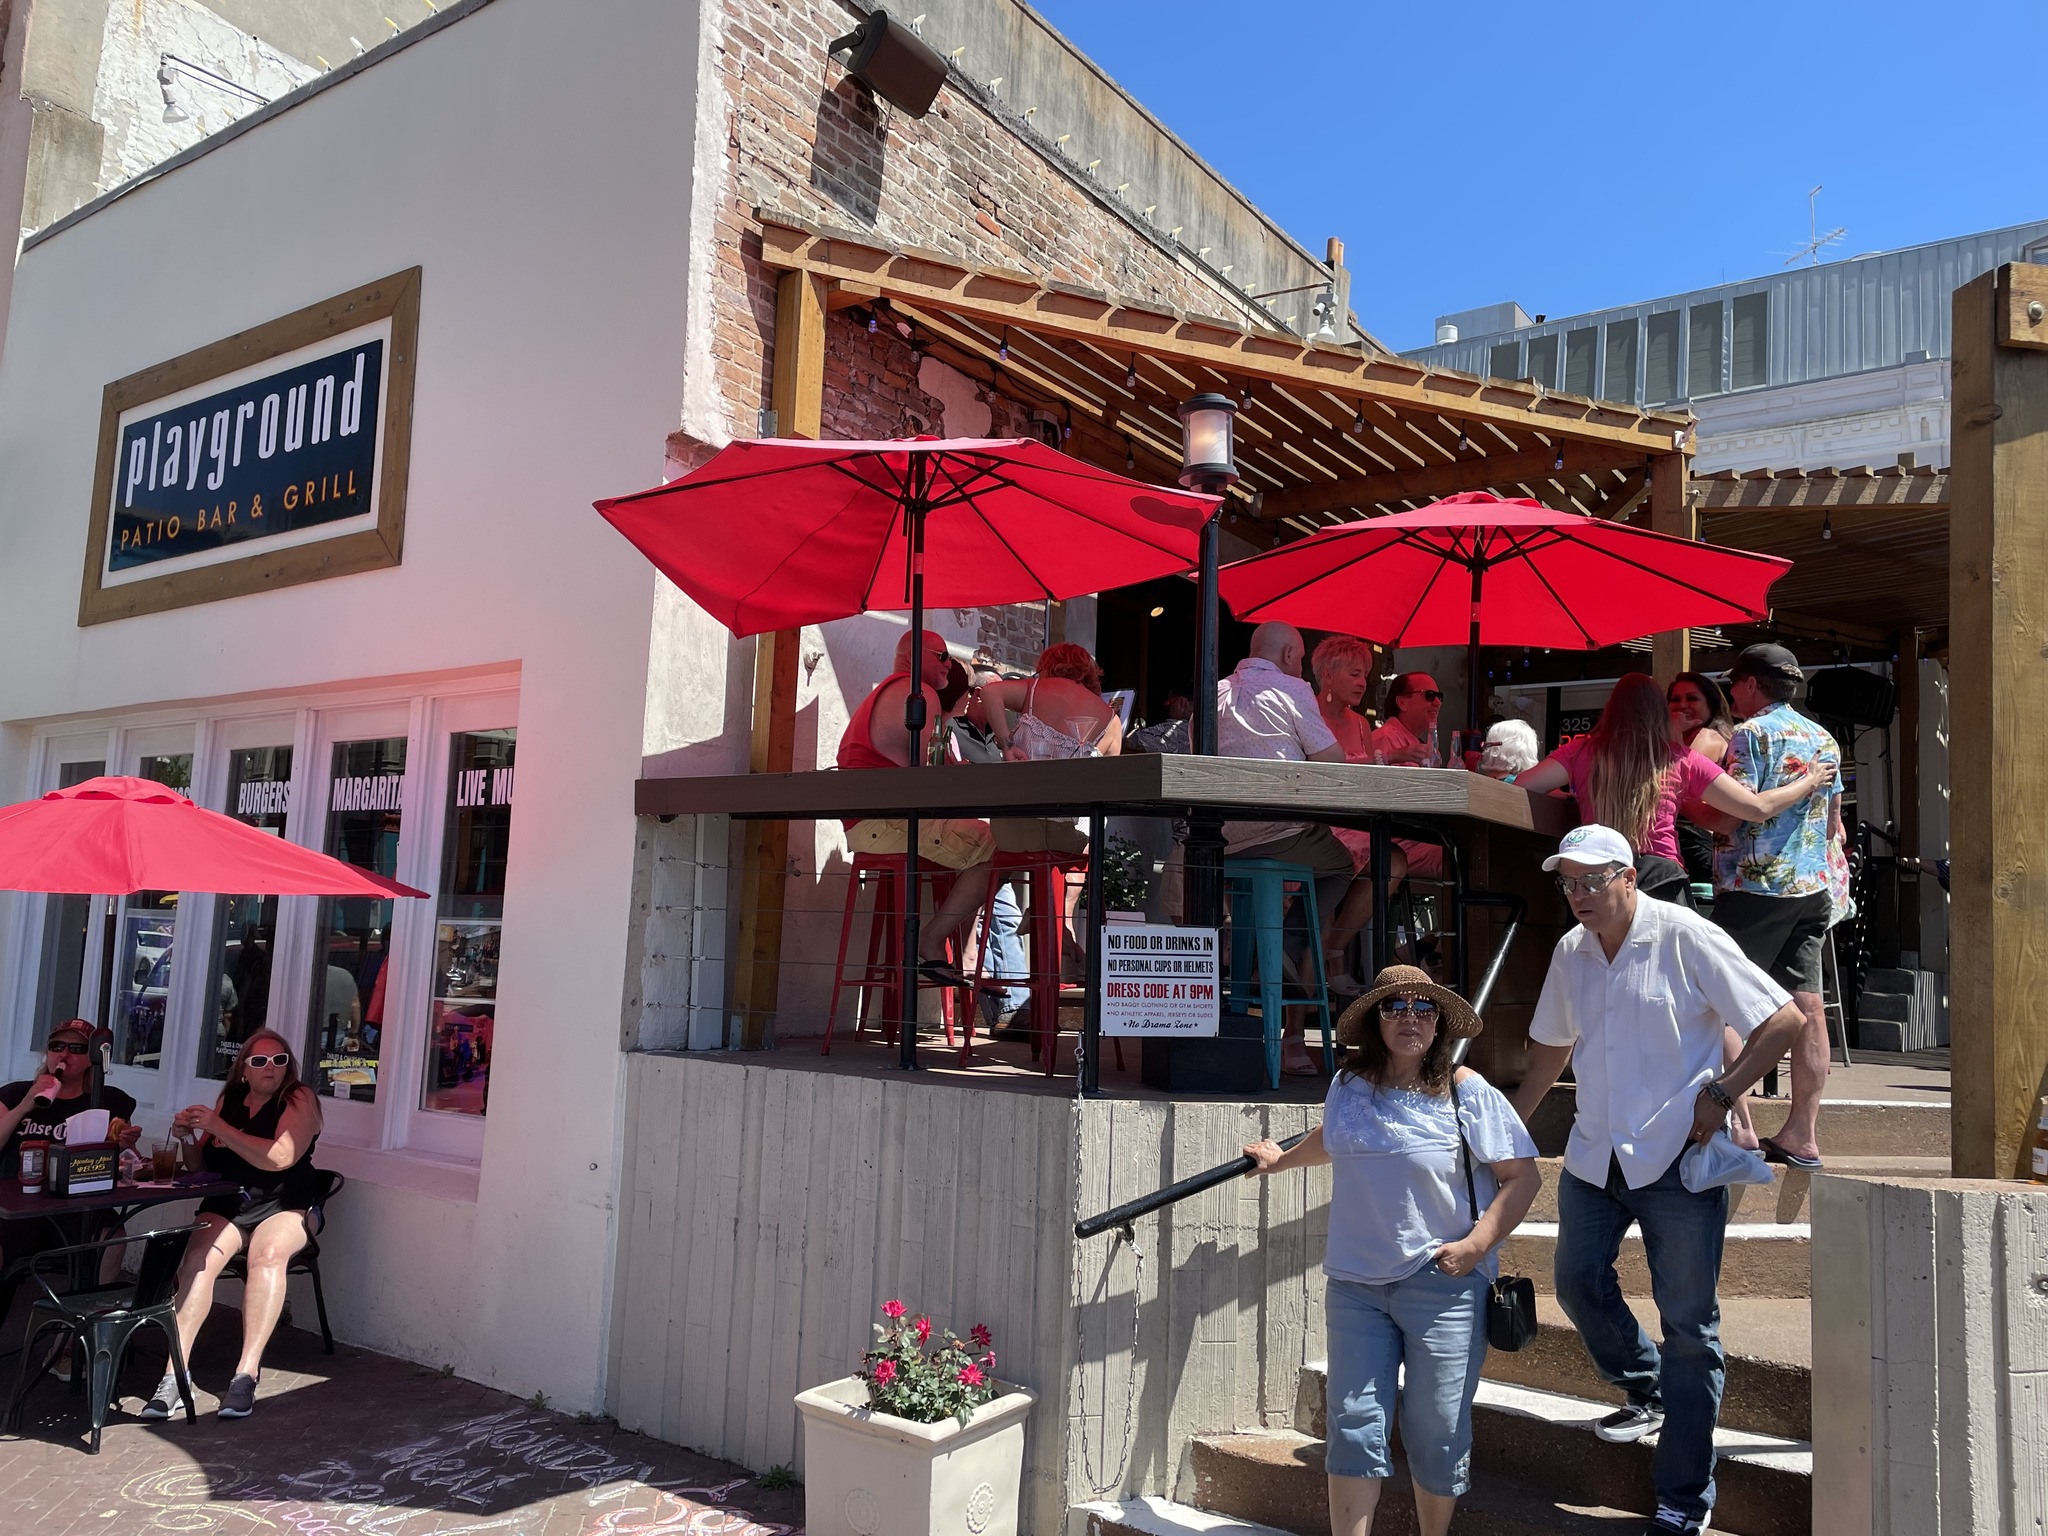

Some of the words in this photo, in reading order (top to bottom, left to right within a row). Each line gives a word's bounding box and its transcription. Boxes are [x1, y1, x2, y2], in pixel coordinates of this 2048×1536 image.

[125, 353, 365, 507] playground
[120, 515, 181, 551] PATIO
[197, 501, 237, 531] BAR
[251, 494, 263, 519] &
[284, 470, 357, 510] GRILL
[1561, 717, 1591, 732] 325
[456, 769, 487, 807] LIVE
[1108, 935, 1121, 949] NO
[1124, 935, 1147, 950] FOOD
[1150, 936, 1163, 950] OR
[1166, 936, 1200, 951] DRINKS
[1203, 937, 1213, 951] IN
[1107, 959, 1117, 972] NO
[1119, 960, 1153, 972] PERSONAL
[1154, 960, 1172, 972] CUPS
[1173, 961, 1182, 973] OR
[1184, 961, 1214, 973] HELMETS
[1107, 982, 1140, 998] DRESS
[1144, 983, 1169, 998] CODE
[1173, 984, 1186, 999] AT
[1190, 984, 1214, 1000] 9PM
[1128, 1019, 1140, 1029] No
[1141, 1019, 1171, 1029] Drama
[1173, 1019, 1193, 1029] Zone
